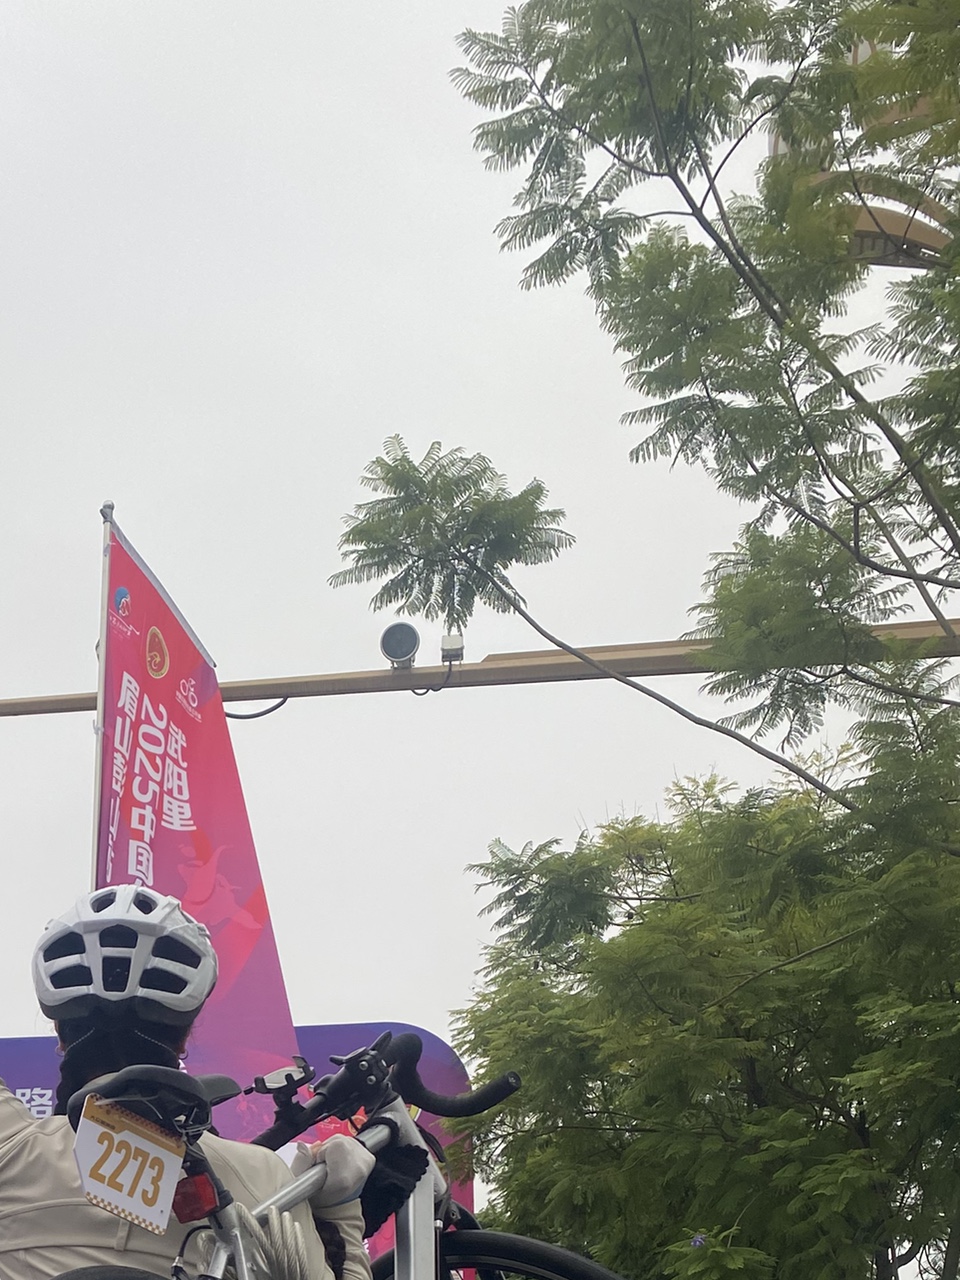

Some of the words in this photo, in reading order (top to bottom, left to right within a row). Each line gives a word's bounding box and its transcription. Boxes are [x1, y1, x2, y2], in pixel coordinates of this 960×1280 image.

[127, 692, 168, 893] 2025中国
[160, 720, 197, 832] 武阳里
[15, 1087, 53, 1119] 路
[88, 1130, 165, 1208] 2273
